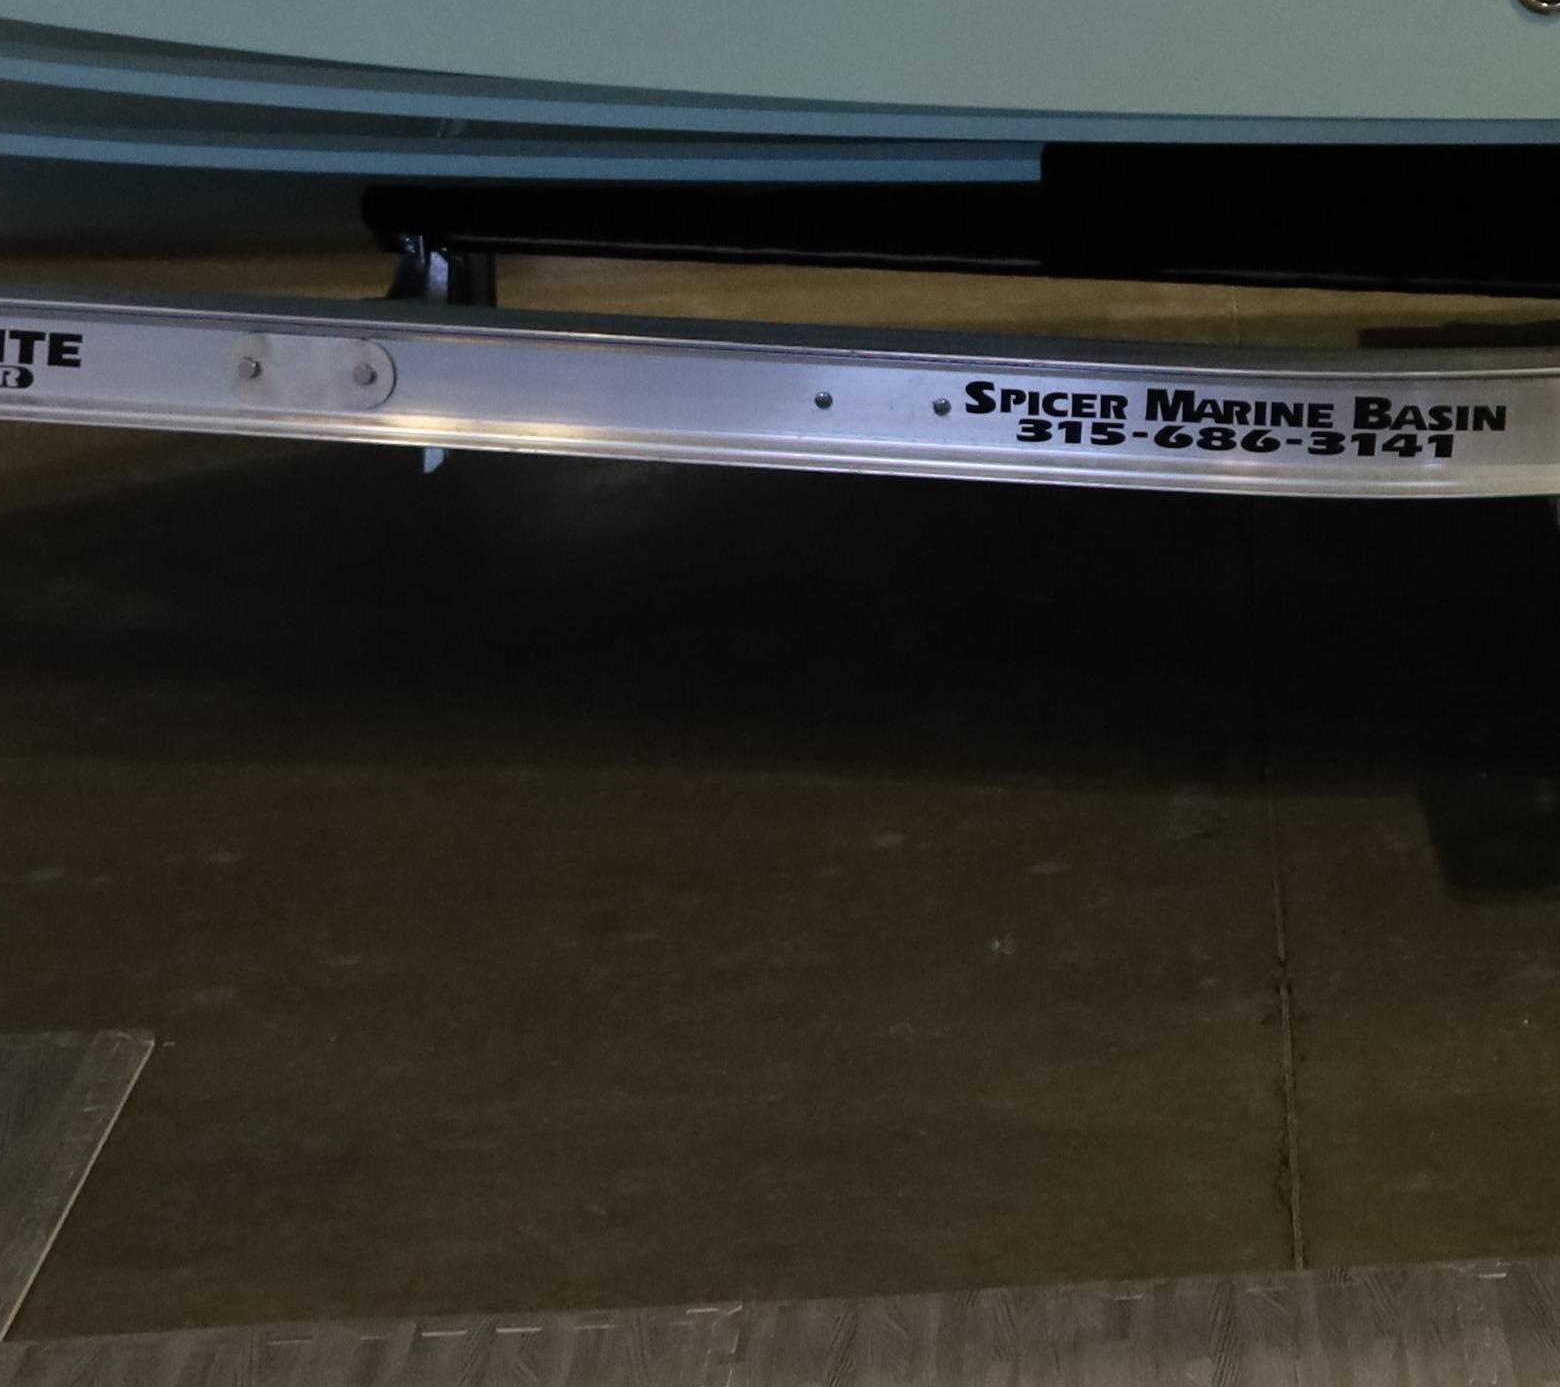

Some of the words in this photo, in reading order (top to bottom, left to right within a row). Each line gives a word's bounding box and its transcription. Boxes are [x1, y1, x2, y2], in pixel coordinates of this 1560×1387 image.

[964, 381, 1129, 419] SPICER
[1145, 389, 1334, 428] MARINE
[1353, 396, 1507, 431] BASIN
[1015, 418, 1454, 458] 315-686-3141
